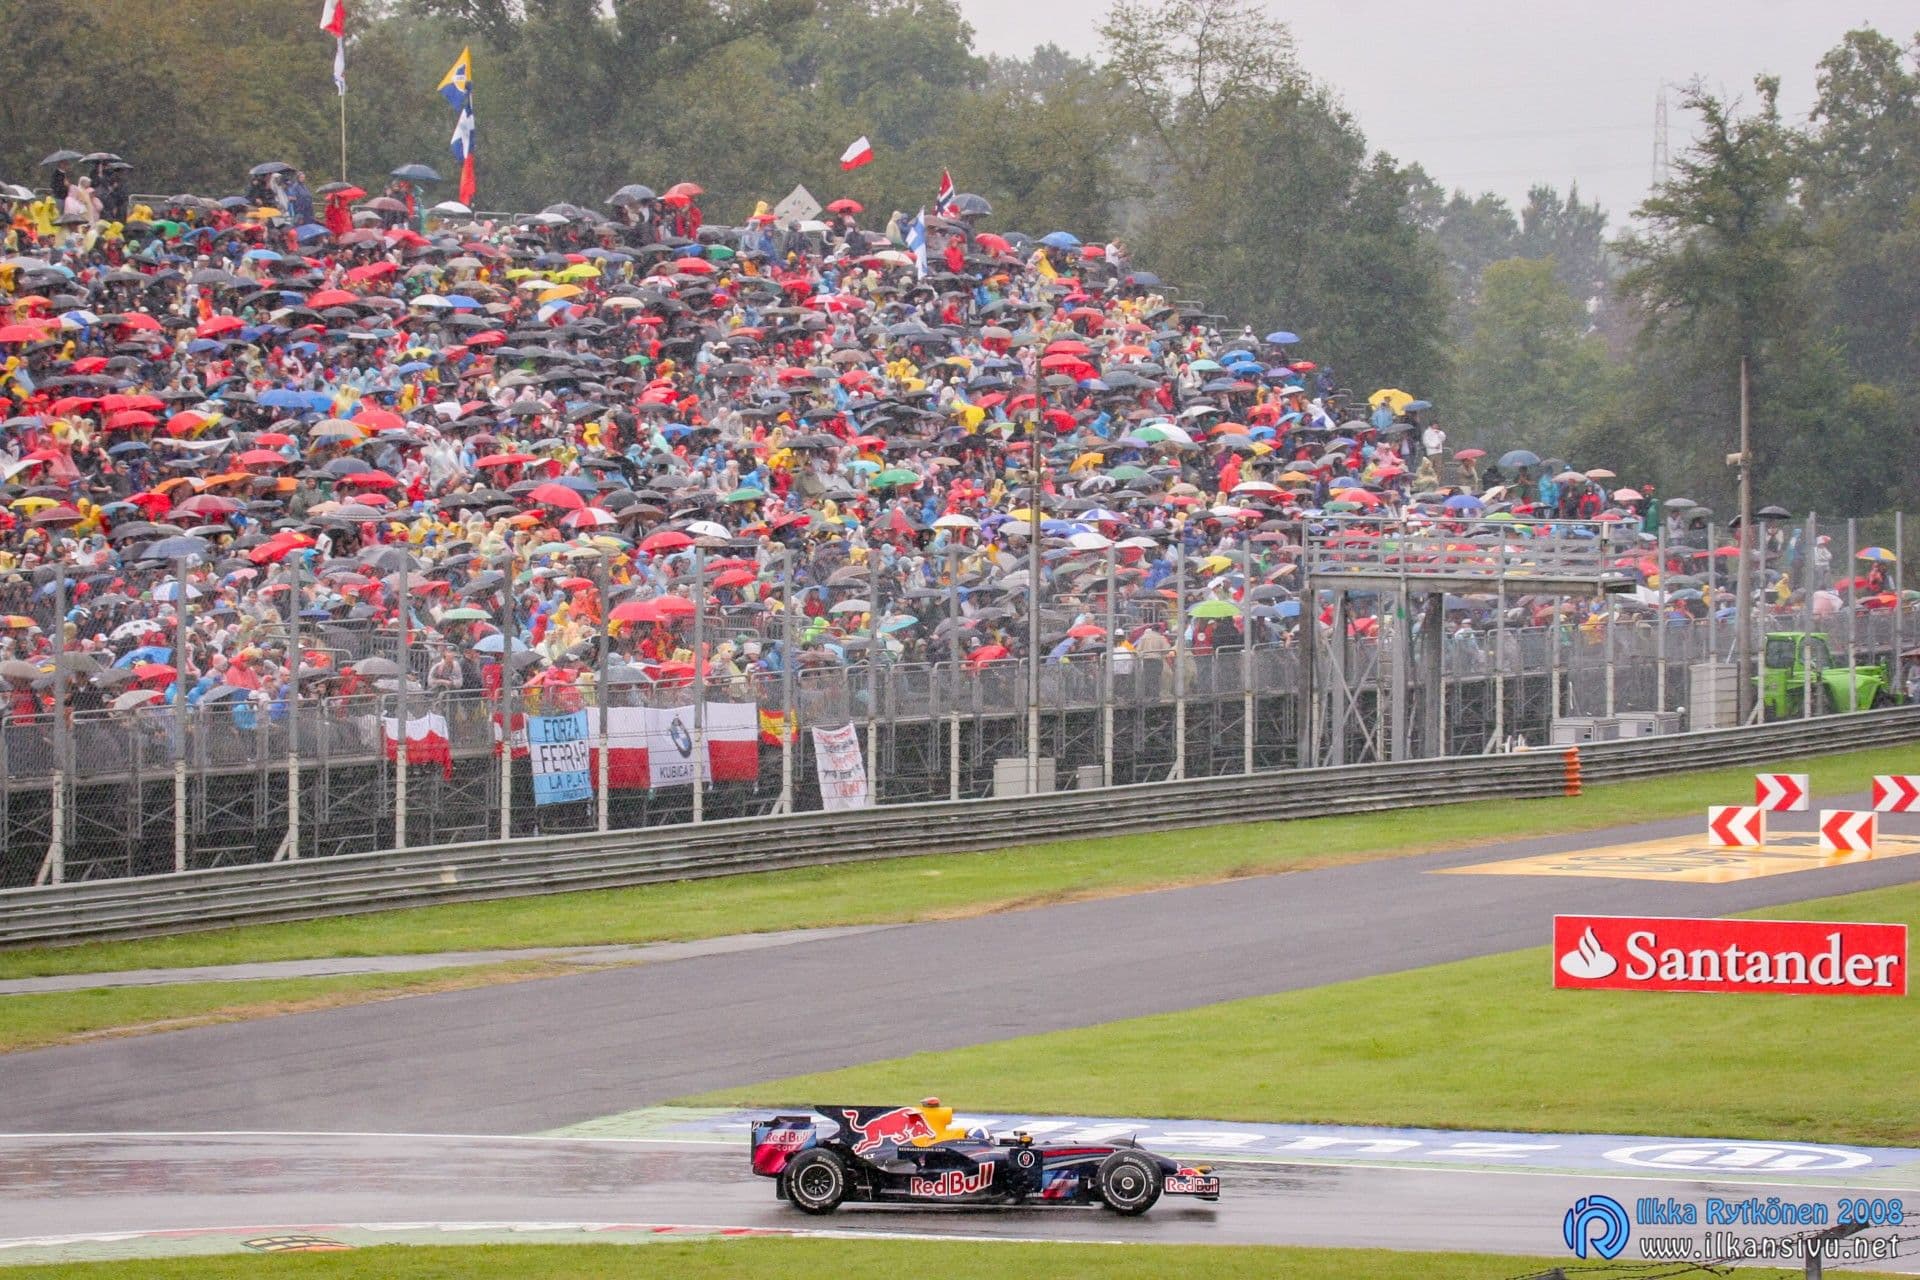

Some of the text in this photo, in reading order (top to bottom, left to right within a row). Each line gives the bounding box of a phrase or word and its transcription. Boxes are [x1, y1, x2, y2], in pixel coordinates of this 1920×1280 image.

[543, 717, 581, 742] FORZA
[540, 740, 587, 773] FERRAR
[567, 771, 588, 789] PLAT
[660, 765, 689, 778] KUBICA
[1626, 931, 1899, 988] Santander
[1022, 1153, 1030, 1165] 9
